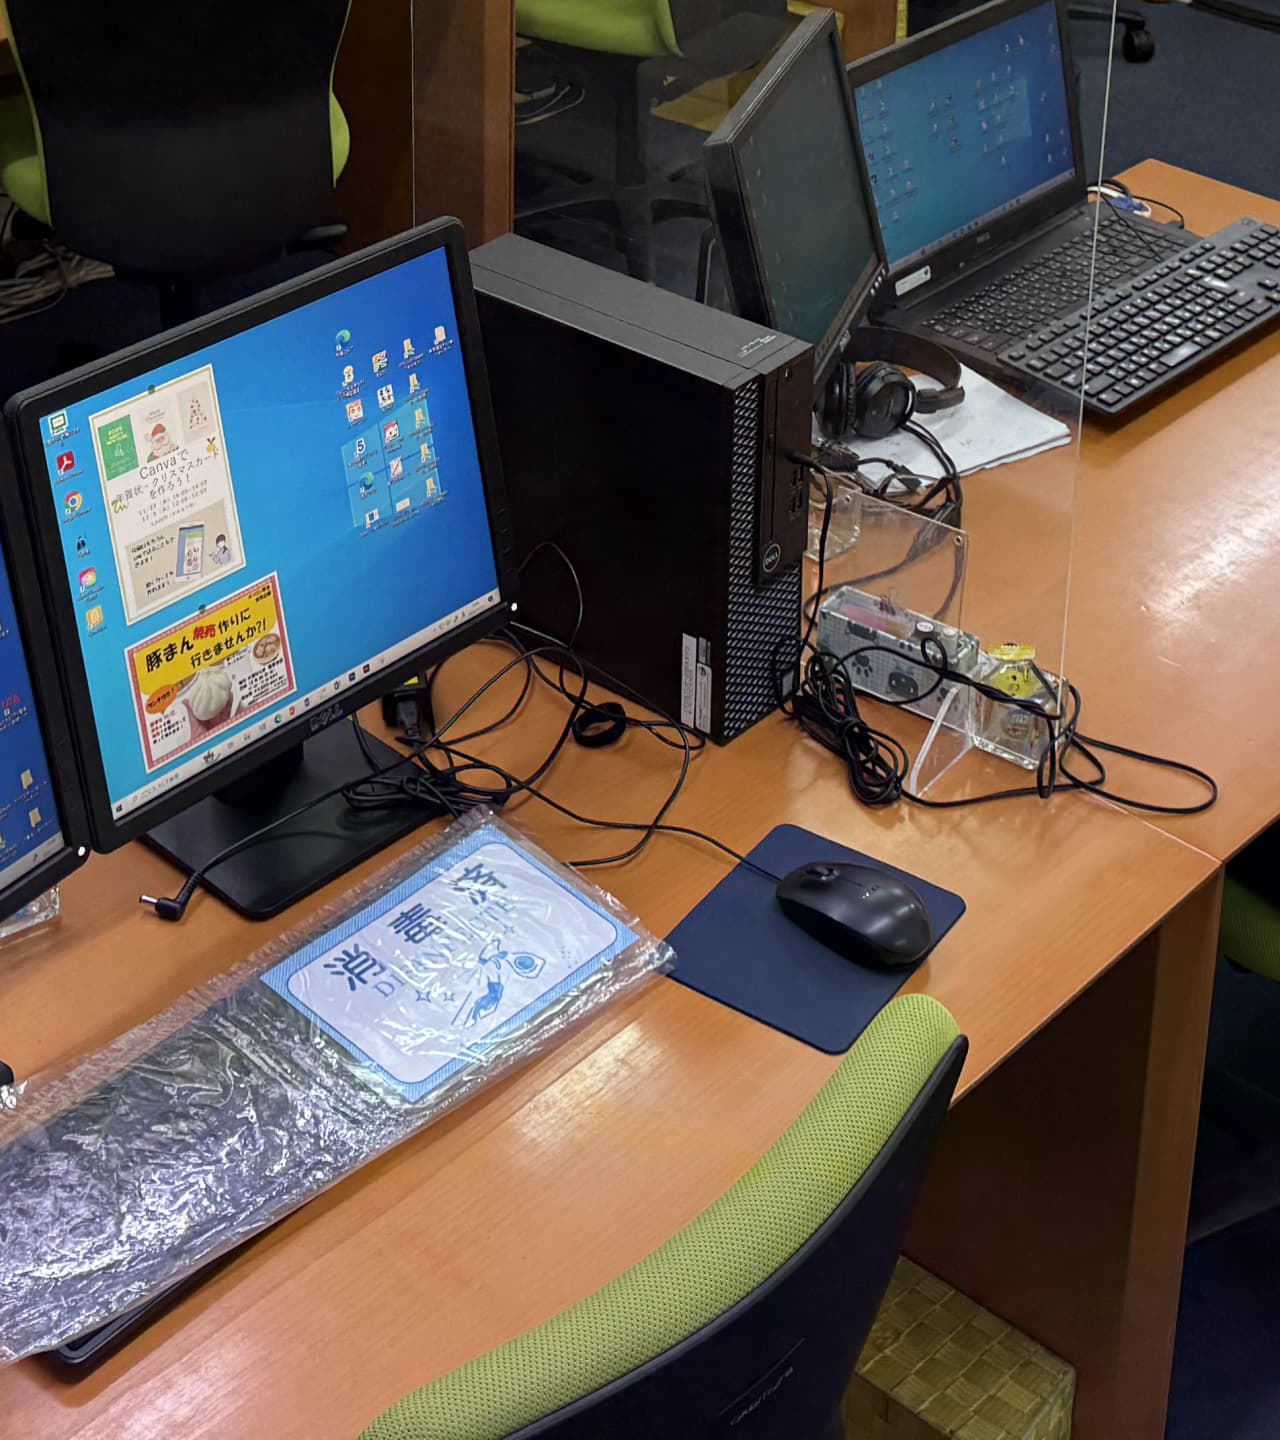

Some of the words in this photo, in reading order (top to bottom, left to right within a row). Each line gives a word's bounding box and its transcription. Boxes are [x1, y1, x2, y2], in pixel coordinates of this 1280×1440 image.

[139, 448, 189, 480] Canvaで
[145, 635, 195, 673] 豚まん
[217, 607, 252, 635] 作りに
[309, 707, 342, 732] DELL
[323, 862, 507, 992] 消毒済
